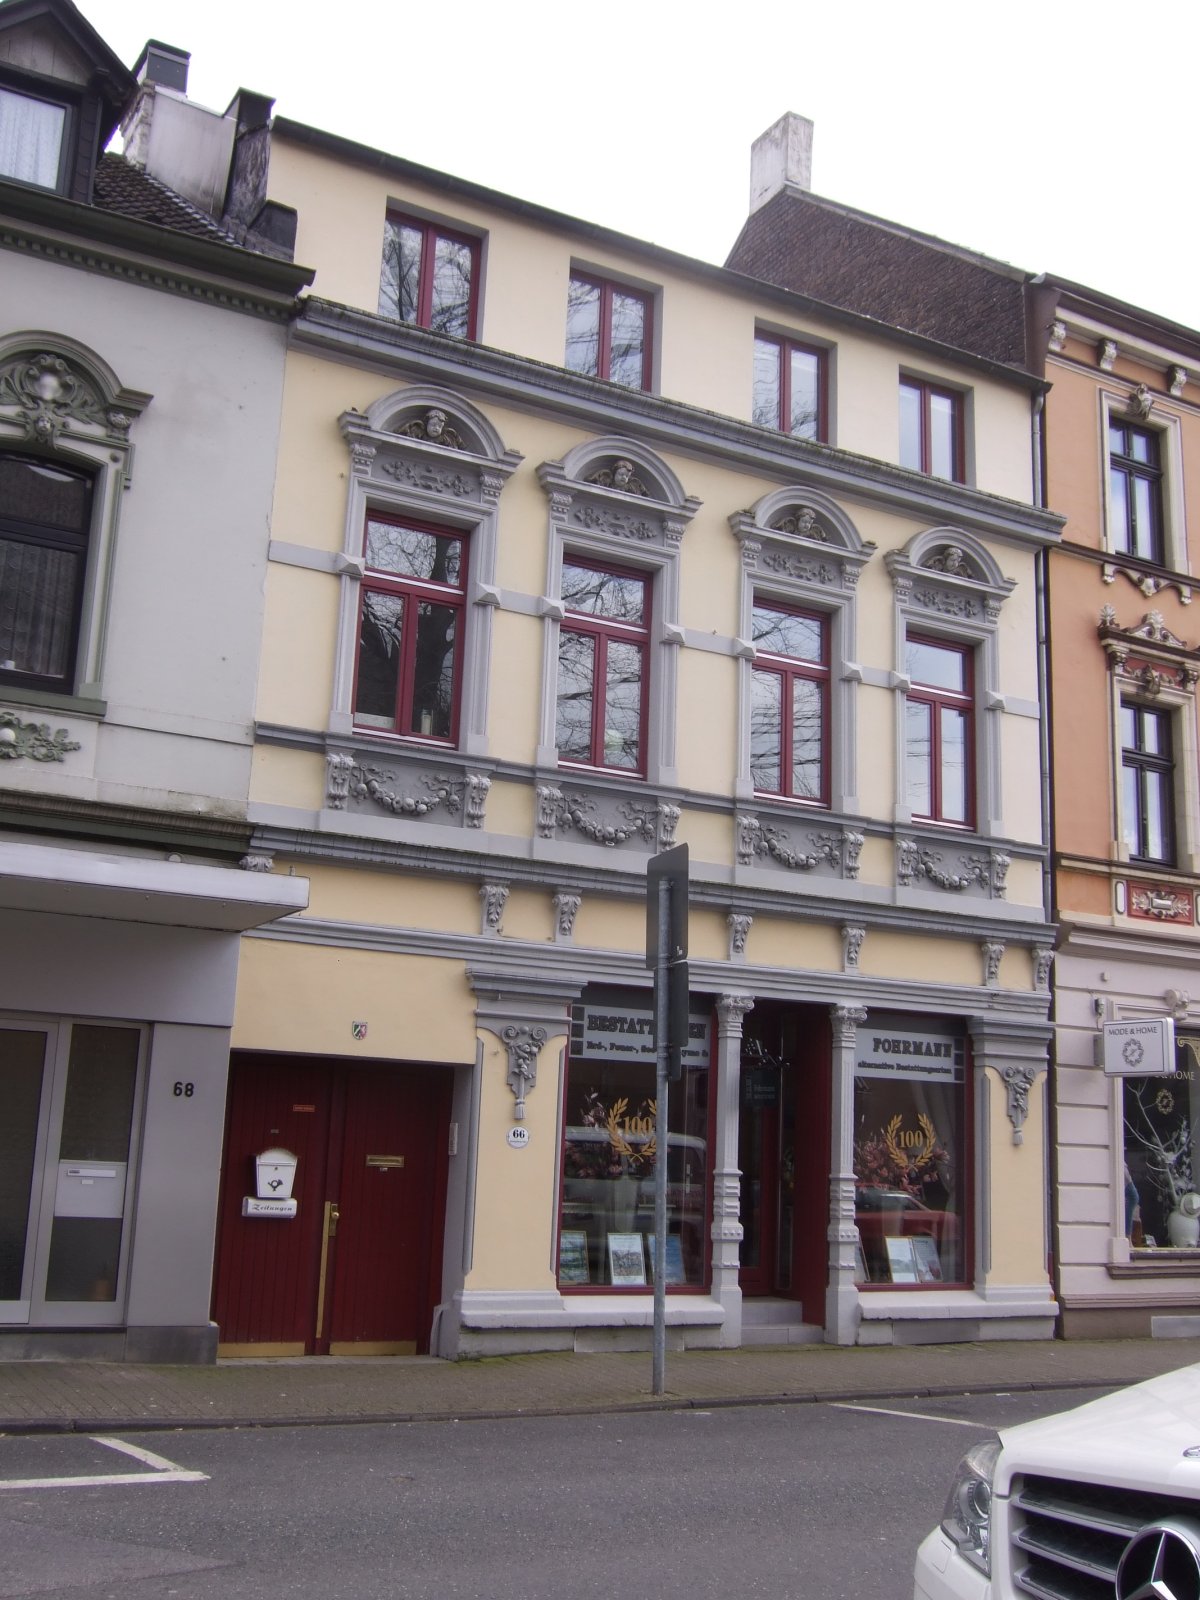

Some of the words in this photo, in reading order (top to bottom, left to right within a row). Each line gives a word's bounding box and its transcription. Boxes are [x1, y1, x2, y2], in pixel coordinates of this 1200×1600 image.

[587, 1014, 707, 1040] BESTATTEN
[1136, 1026, 1158, 1034] HOME
[173, 1081, 195, 1098] 68
[512, 1129, 525, 1139] 66
[623, 1116, 653, 1137] 100
[899, 1130, 924, 1148] 100
[252, 1203, 292, 1211] Zeitungen
